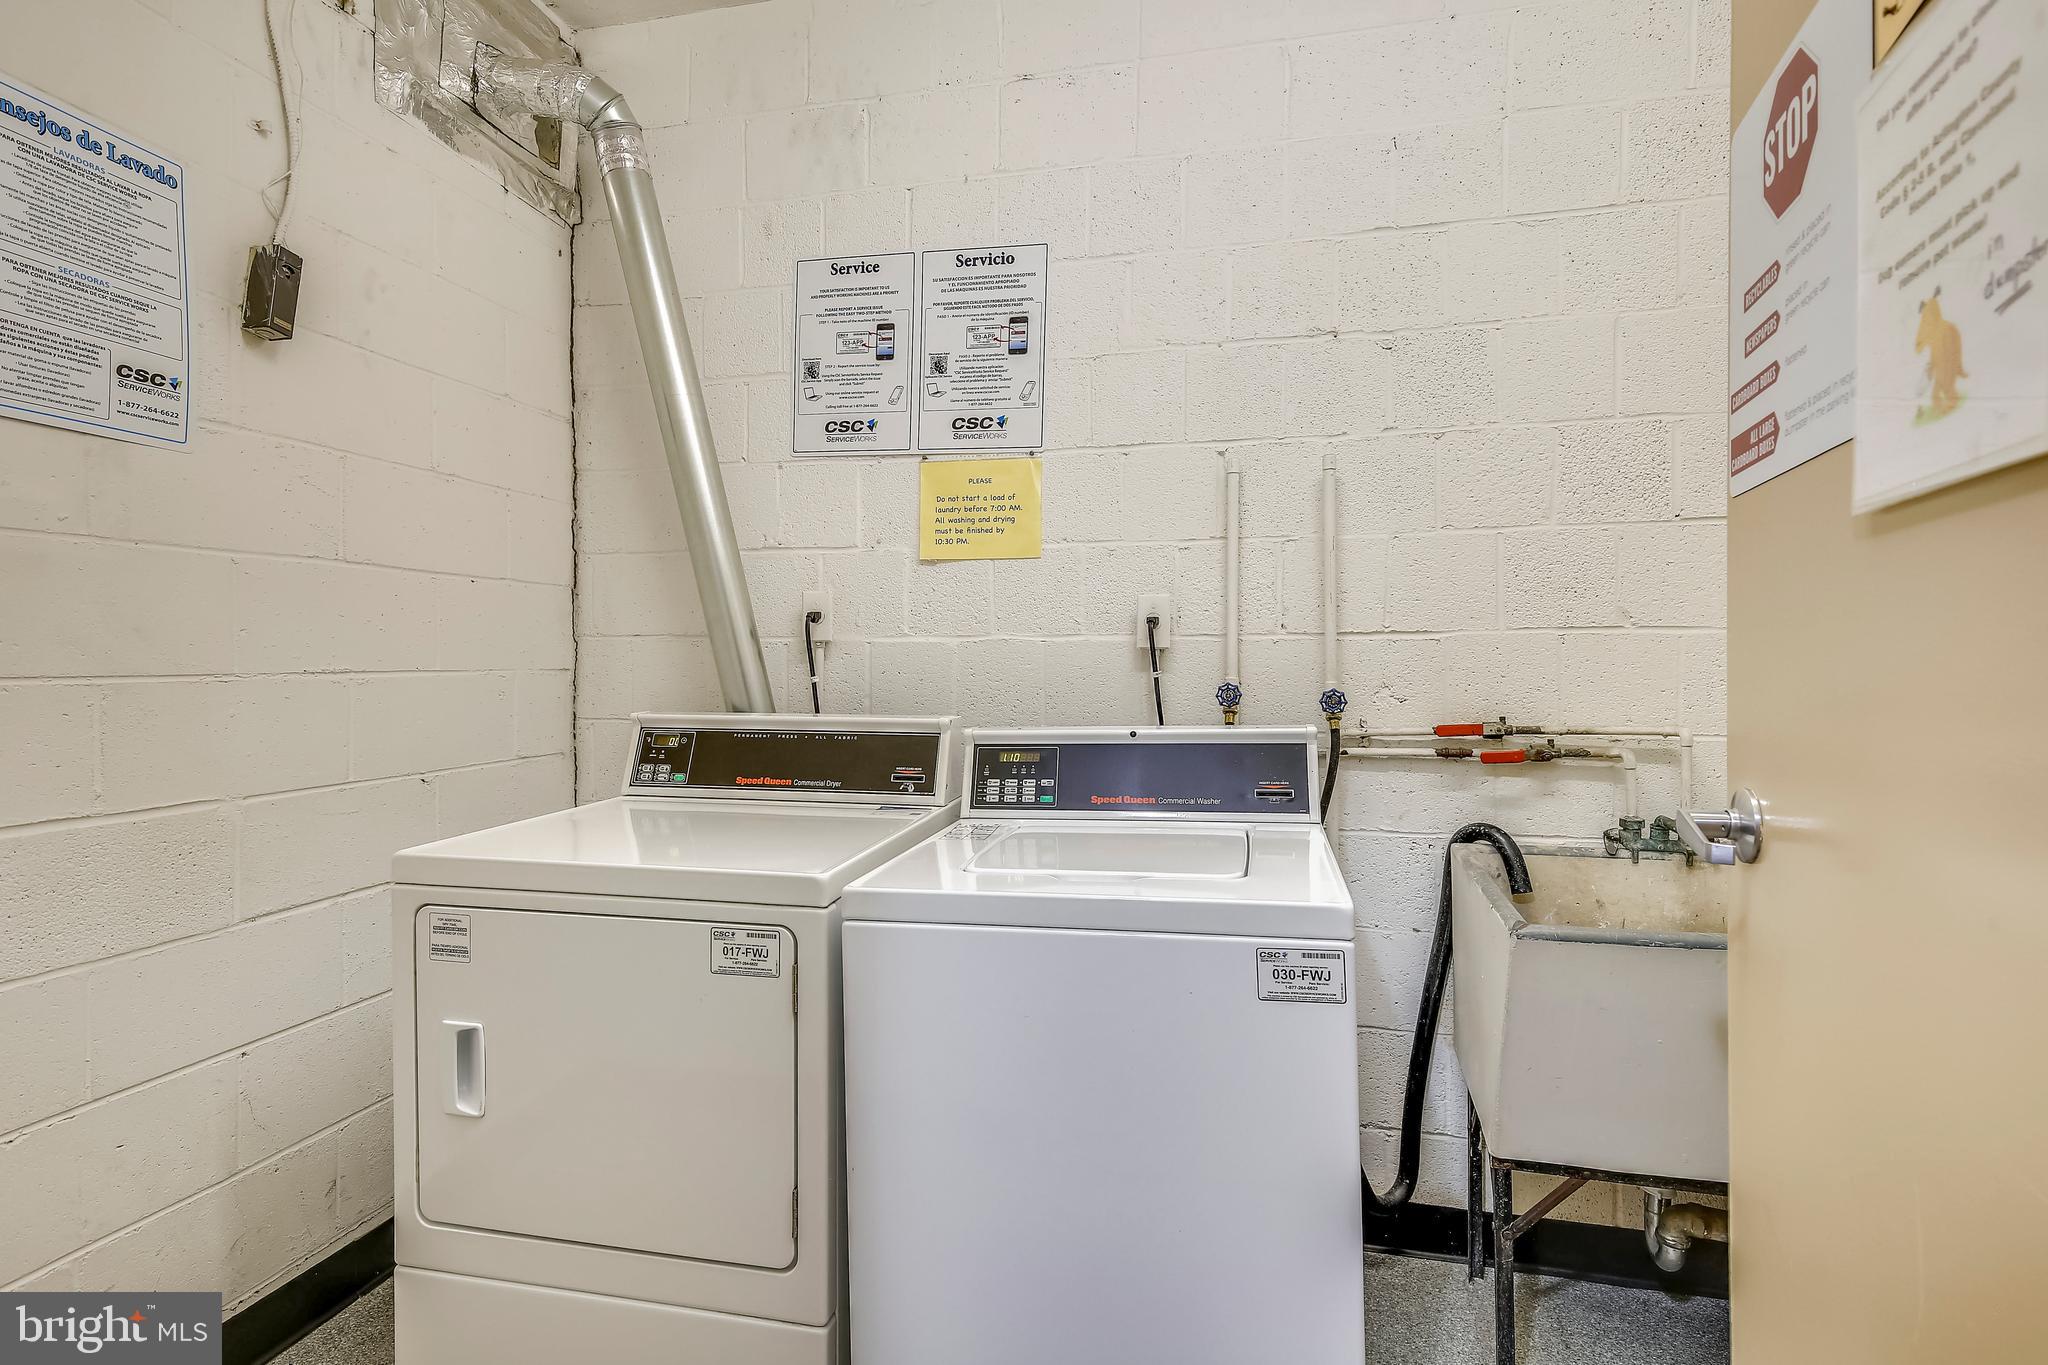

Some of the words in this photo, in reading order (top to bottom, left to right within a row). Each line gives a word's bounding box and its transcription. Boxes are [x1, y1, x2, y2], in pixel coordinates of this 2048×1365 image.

[1765, 74, 1816, 187] STOP
[53, 146, 106, 175] LAVADORAS
[76, 130, 102, 155] de
[106, 141, 177, 189] Lavado
[71, 162, 105, 181] RESULTADOS
[830, 261, 880, 275] Service
[955, 252, 1015, 268] Servicio
[1, 256, 17, 265] PARA
[19, 262, 46, 274] OBTENER
[48, 271, 73, 283] MEJORES
[75, 280, 108, 294] RESULTADOS
[110, 291, 132, 302] CUANDO
[133, 299, 149, 308] SEQUE
[58, 266, 110, 288] SECADORAS
[1745, 264, 1778, 309] RECYCLABLES
[9, 320, 28, 329] TENGA
[38, 328, 60, 338] CUENTA
[81, 340, 105, 350] lavadoras
[12, 265, 28, 275] ROPA
[30, 271, 43, 279] CON
[44, 275, 56, 284] UNA
[58, 280, 88, 294] SECADORA
[116, 364, 166, 387] CSC
[1746, 315, 1778, 353] NEWSPAPERS
[7, 333, 35, 345] siguientes
[36, 341, 59, 351] acciones
[78, 352, 98, 362] podrían
[17, 329, 49, 342] comerciales
[58, 340, 72, 348] están
[73, 344, 99, 355] diseñadas
[28, 345, 51, 356] máquina
[116, 364, 166, 387] CSC
[1732, 378, 1759, 410] CARDBOARD
[1759, 366, 1777, 389] BOXES
[118, 399, 179, 418] 1-877-264-6622
[824, 420, 865, 433] CSC
[951, 416, 994, 429] CSC
[1750, 427, 1760, 445] ALL
[1760, 416, 1775, 438] LARGE
[1731, 446, 1759, 474] CARDBOARD
[1759, 434, 1776, 458] BOXES
[948, 516, 976, 525] washing
[993, 515, 1016, 524] drying
[995, 527, 1005, 535] by
[736, 776, 763, 785] Speed
[764, 777, 792, 785] Queen
[826, 780, 842, 788] Dryer
[1091, 795, 1122, 805] Speed
[1124, 795, 1155, 804] Queen
[1158, 797, 1196, 805] Commercial
[1197, 797, 1221, 805] Washer
[723, 946, 769, 958] 017-FWJ
[1272, 968, 1331, 982] 030-FWJ
